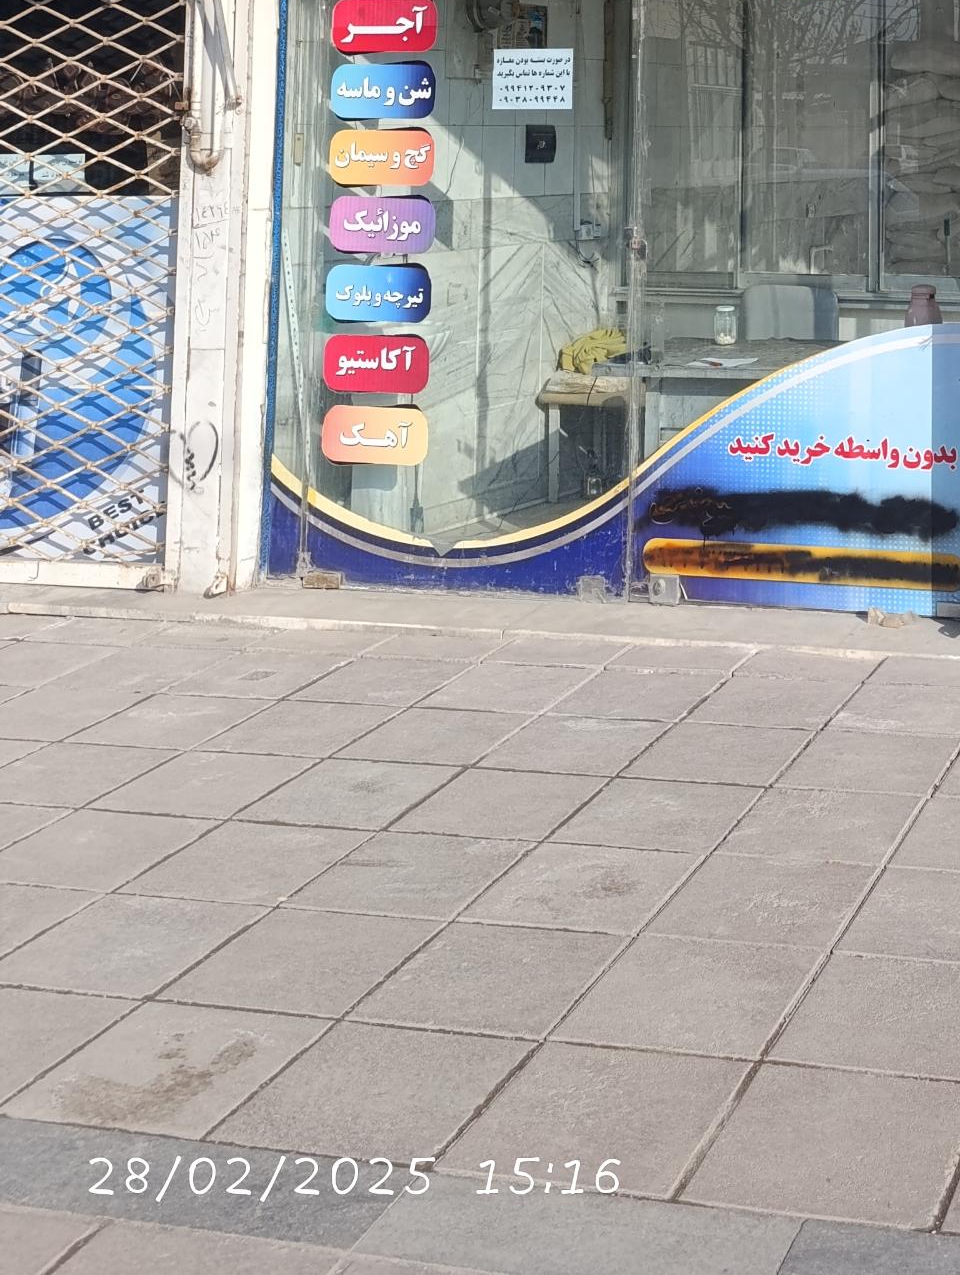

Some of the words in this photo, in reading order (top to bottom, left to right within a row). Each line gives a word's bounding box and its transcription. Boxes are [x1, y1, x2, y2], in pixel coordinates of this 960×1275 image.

[341, 6, 428, 43] آجر
[336, 77, 380, 99] ماسه
[384, 87, 395, 107] و
[399, 79, 432, 106] شن
[334, 142, 388, 168] سیمان
[391, 151, 401, 168] و
[405, 143, 431, 168] گچ
[335, 284, 373, 307] بلوک
[383, 287, 424, 309] تیرچه
[336, 346, 416, 376] آکاستیو
[339, 421, 412, 448] آهک
[728, 434, 775, 461] کنید
[777, 436, 831, 466] خرید
[833, 437, 900, 469] واسطه
[902, 443, 958, 470] بدون
